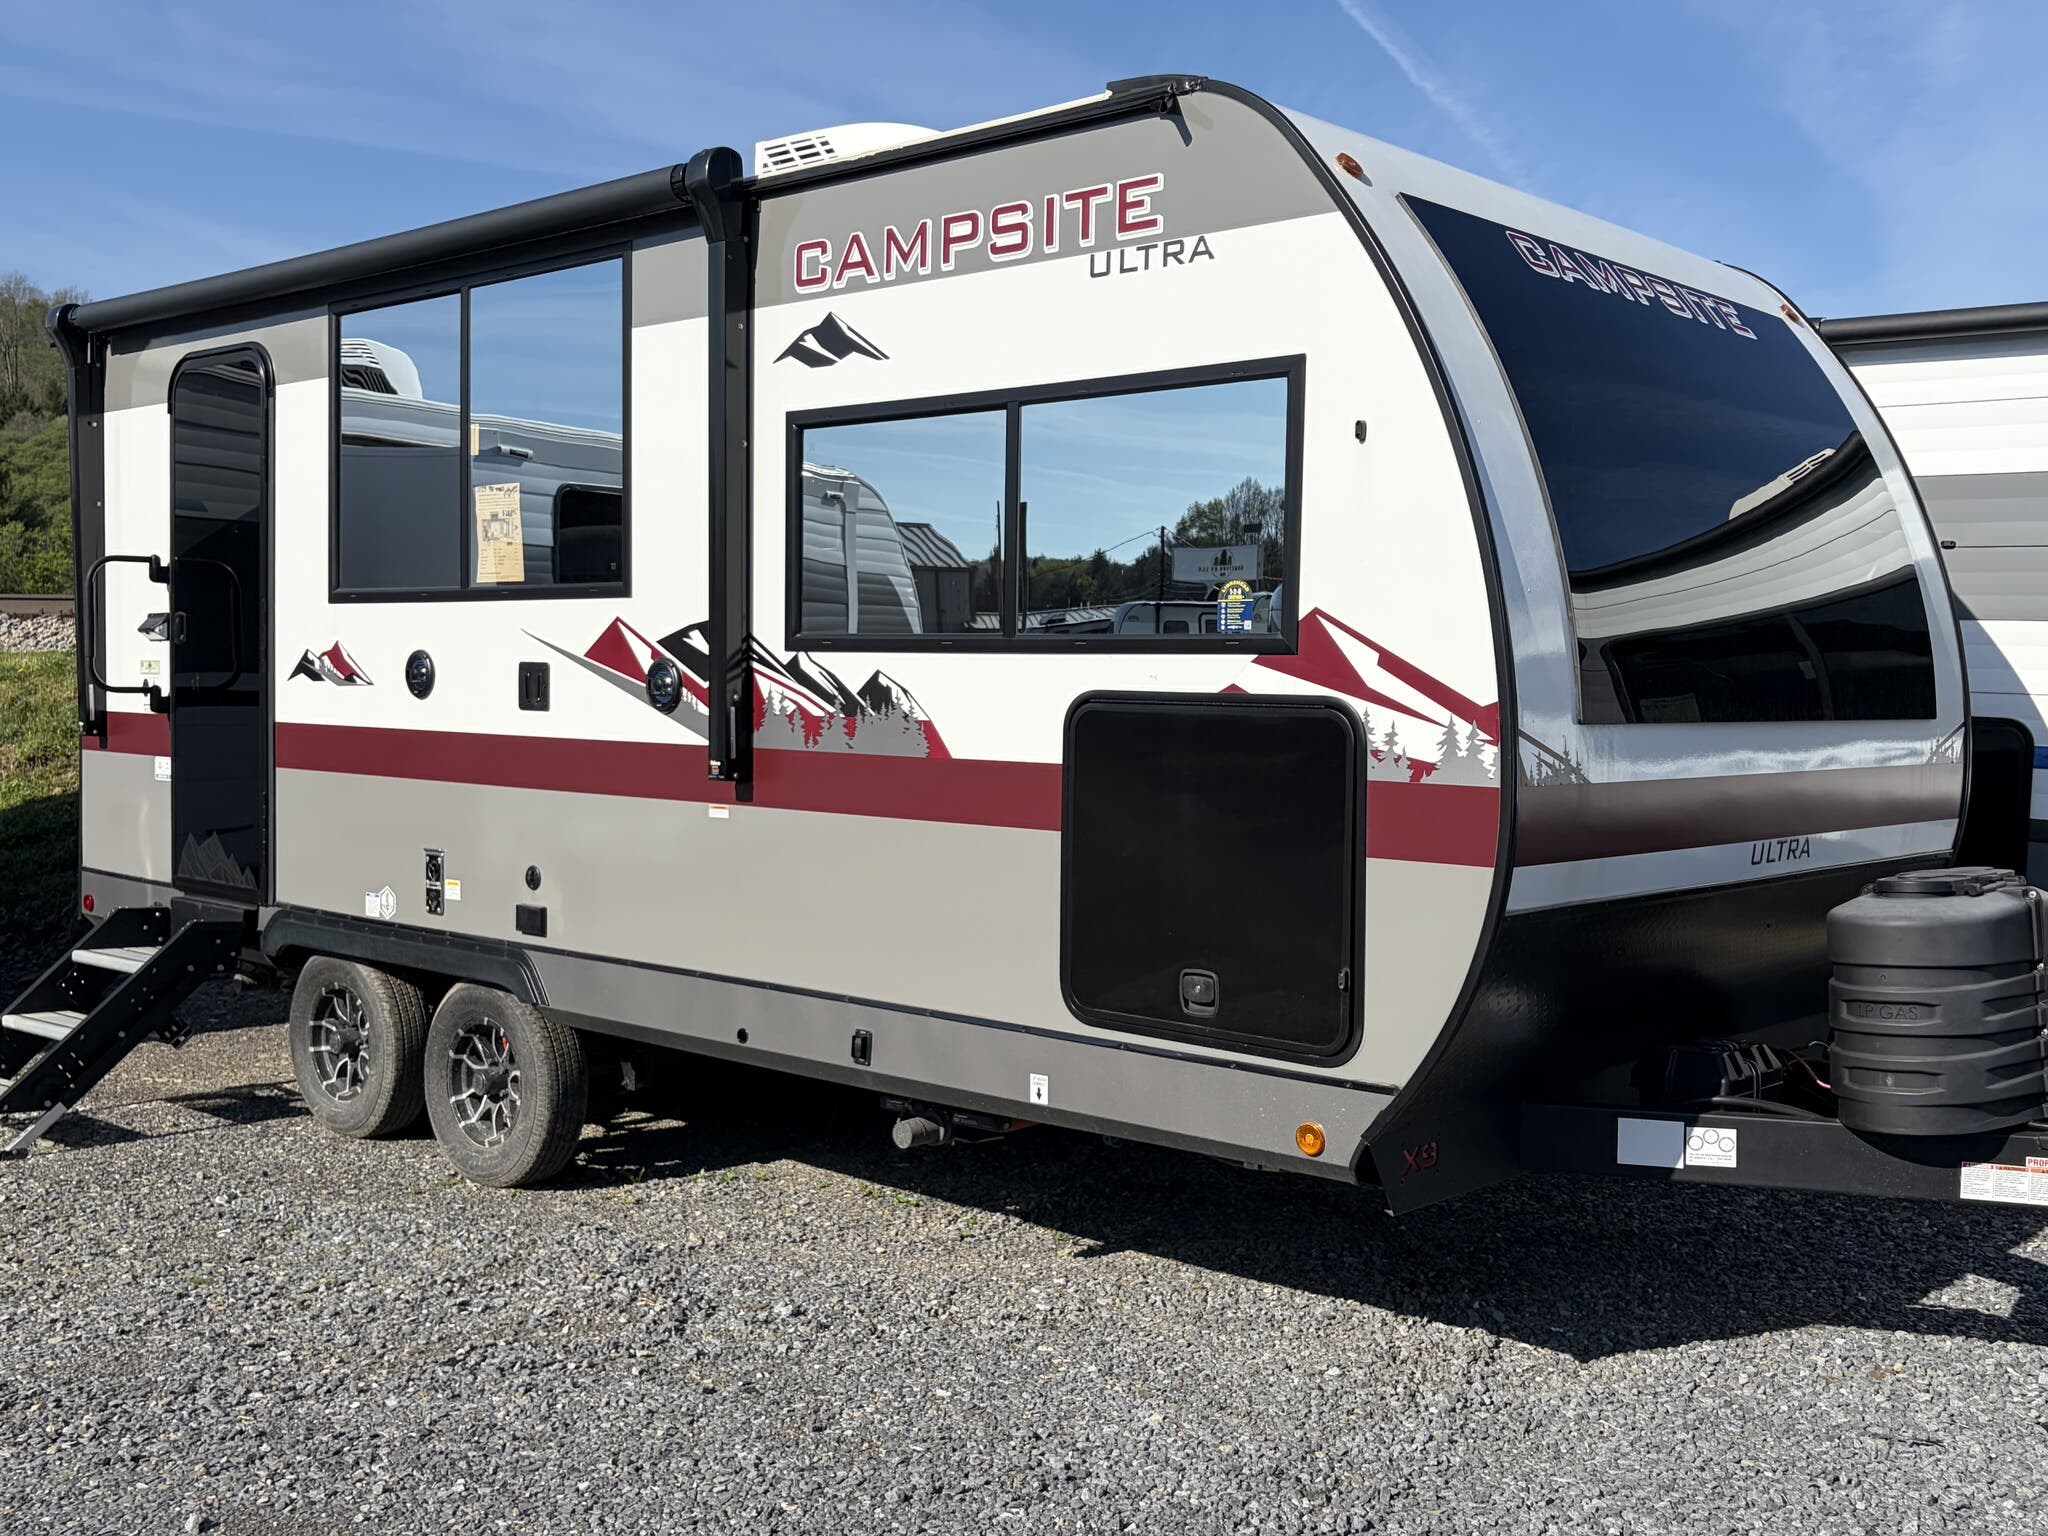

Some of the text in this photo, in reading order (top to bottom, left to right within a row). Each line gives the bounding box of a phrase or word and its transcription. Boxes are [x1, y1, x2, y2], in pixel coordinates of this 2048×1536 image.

[794, 172, 1164, 294] CAMPSITE
[1089, 235, 1215, 279] ULTRA
[1505, 230, 1758, 340] CAMPSITE
[1750, 837, 1810, 866] ULTRA
[1857, 1003, 1919, 1020] LP GAS
